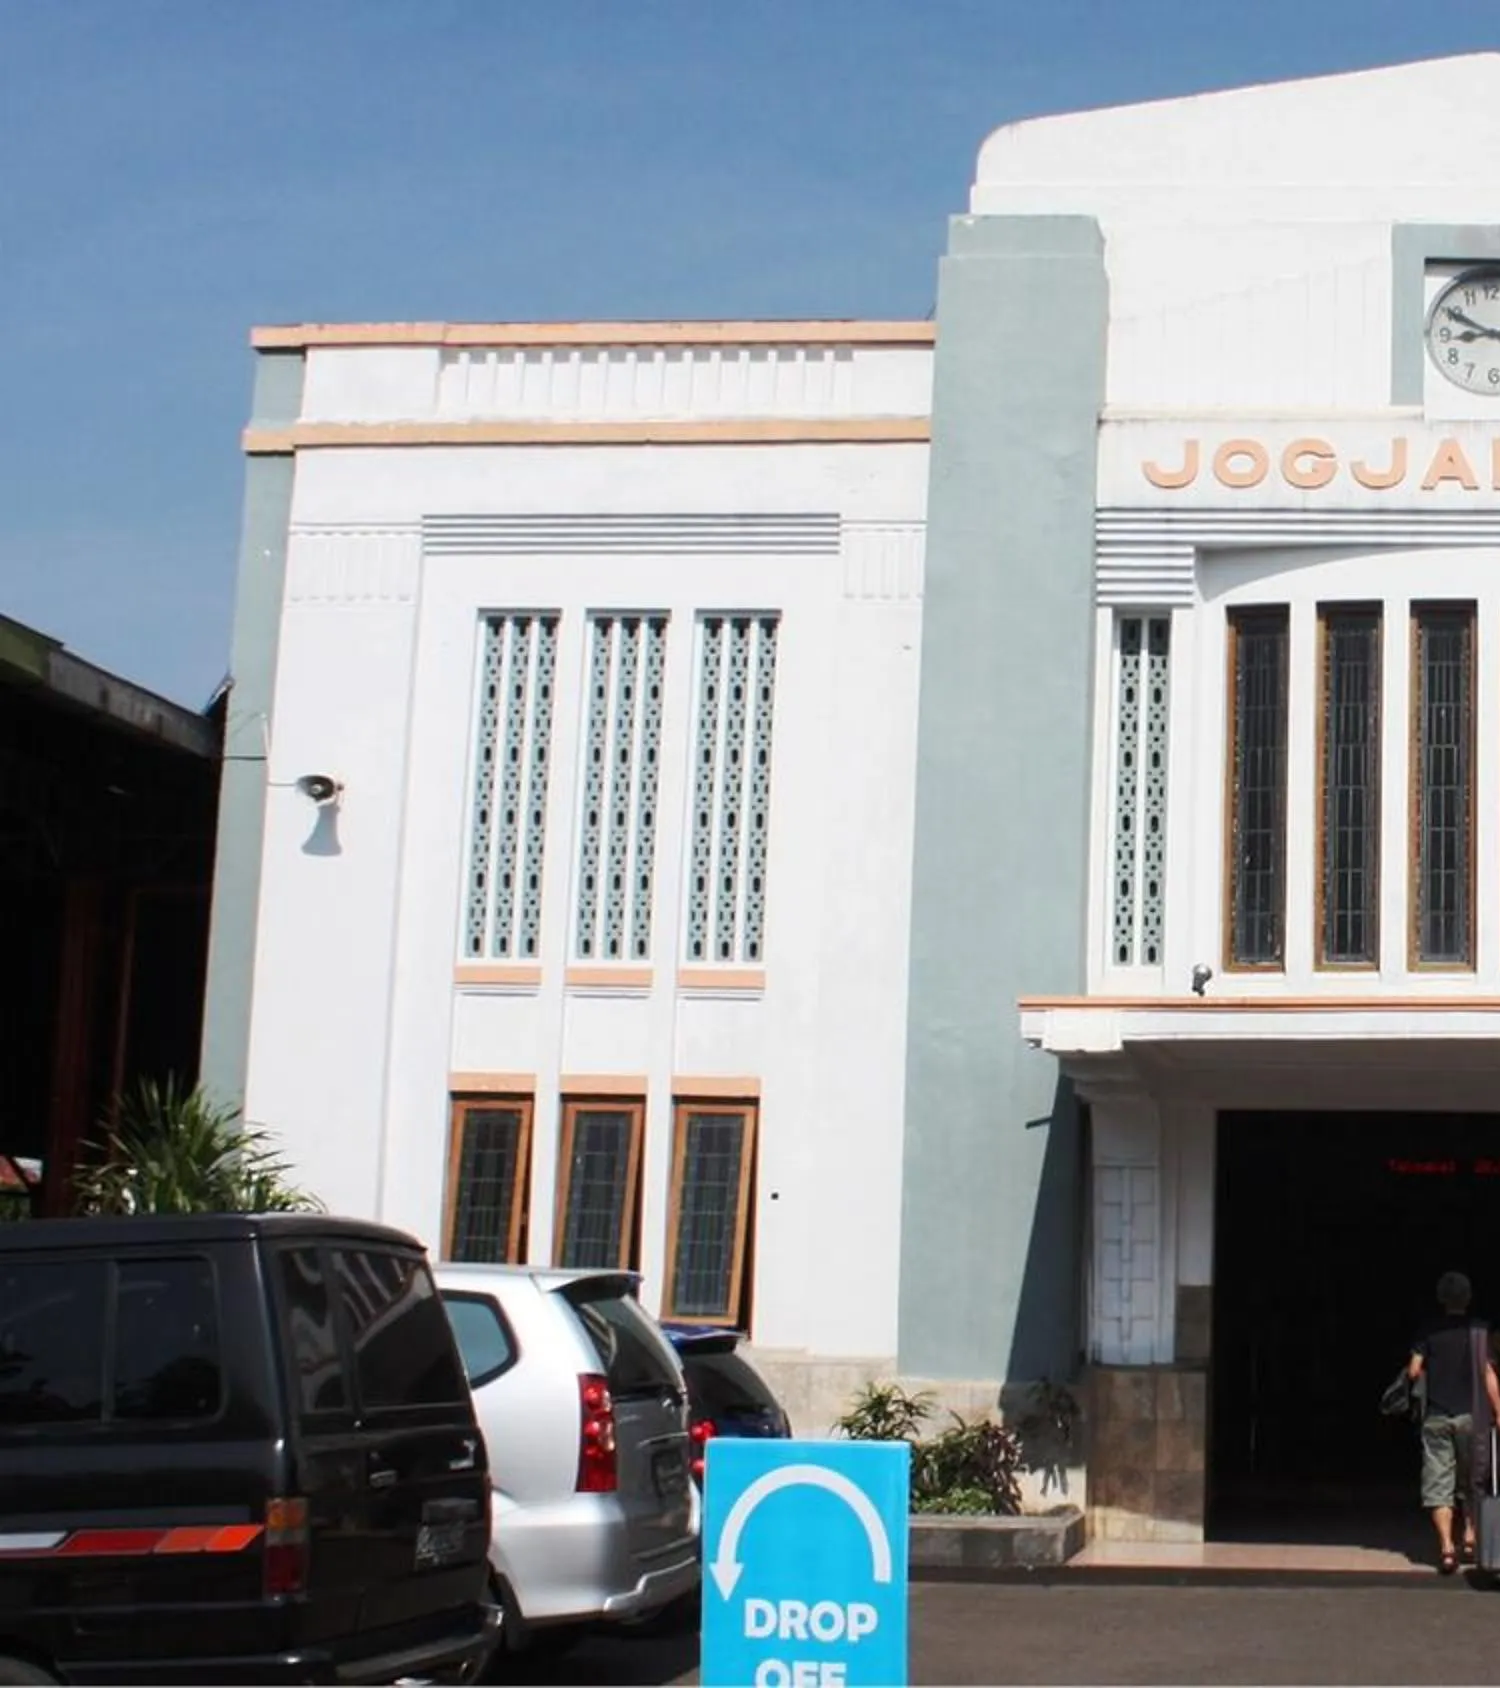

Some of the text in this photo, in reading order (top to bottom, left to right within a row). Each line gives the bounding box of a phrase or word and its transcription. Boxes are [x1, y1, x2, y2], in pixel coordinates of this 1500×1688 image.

[1463, 288, 1478, 306] 11
[1482, 284, 1500, 301] 12
[1439, 327, 1451, 344] 9
[1447, 347, 1459, 365] 8
[1464, 363, 1476, 380] 7
[1487, 367, 1500, 385] 6
[743, 1598, 879, 1642] DROP
[754, 1658, 848, 1686] OFF
